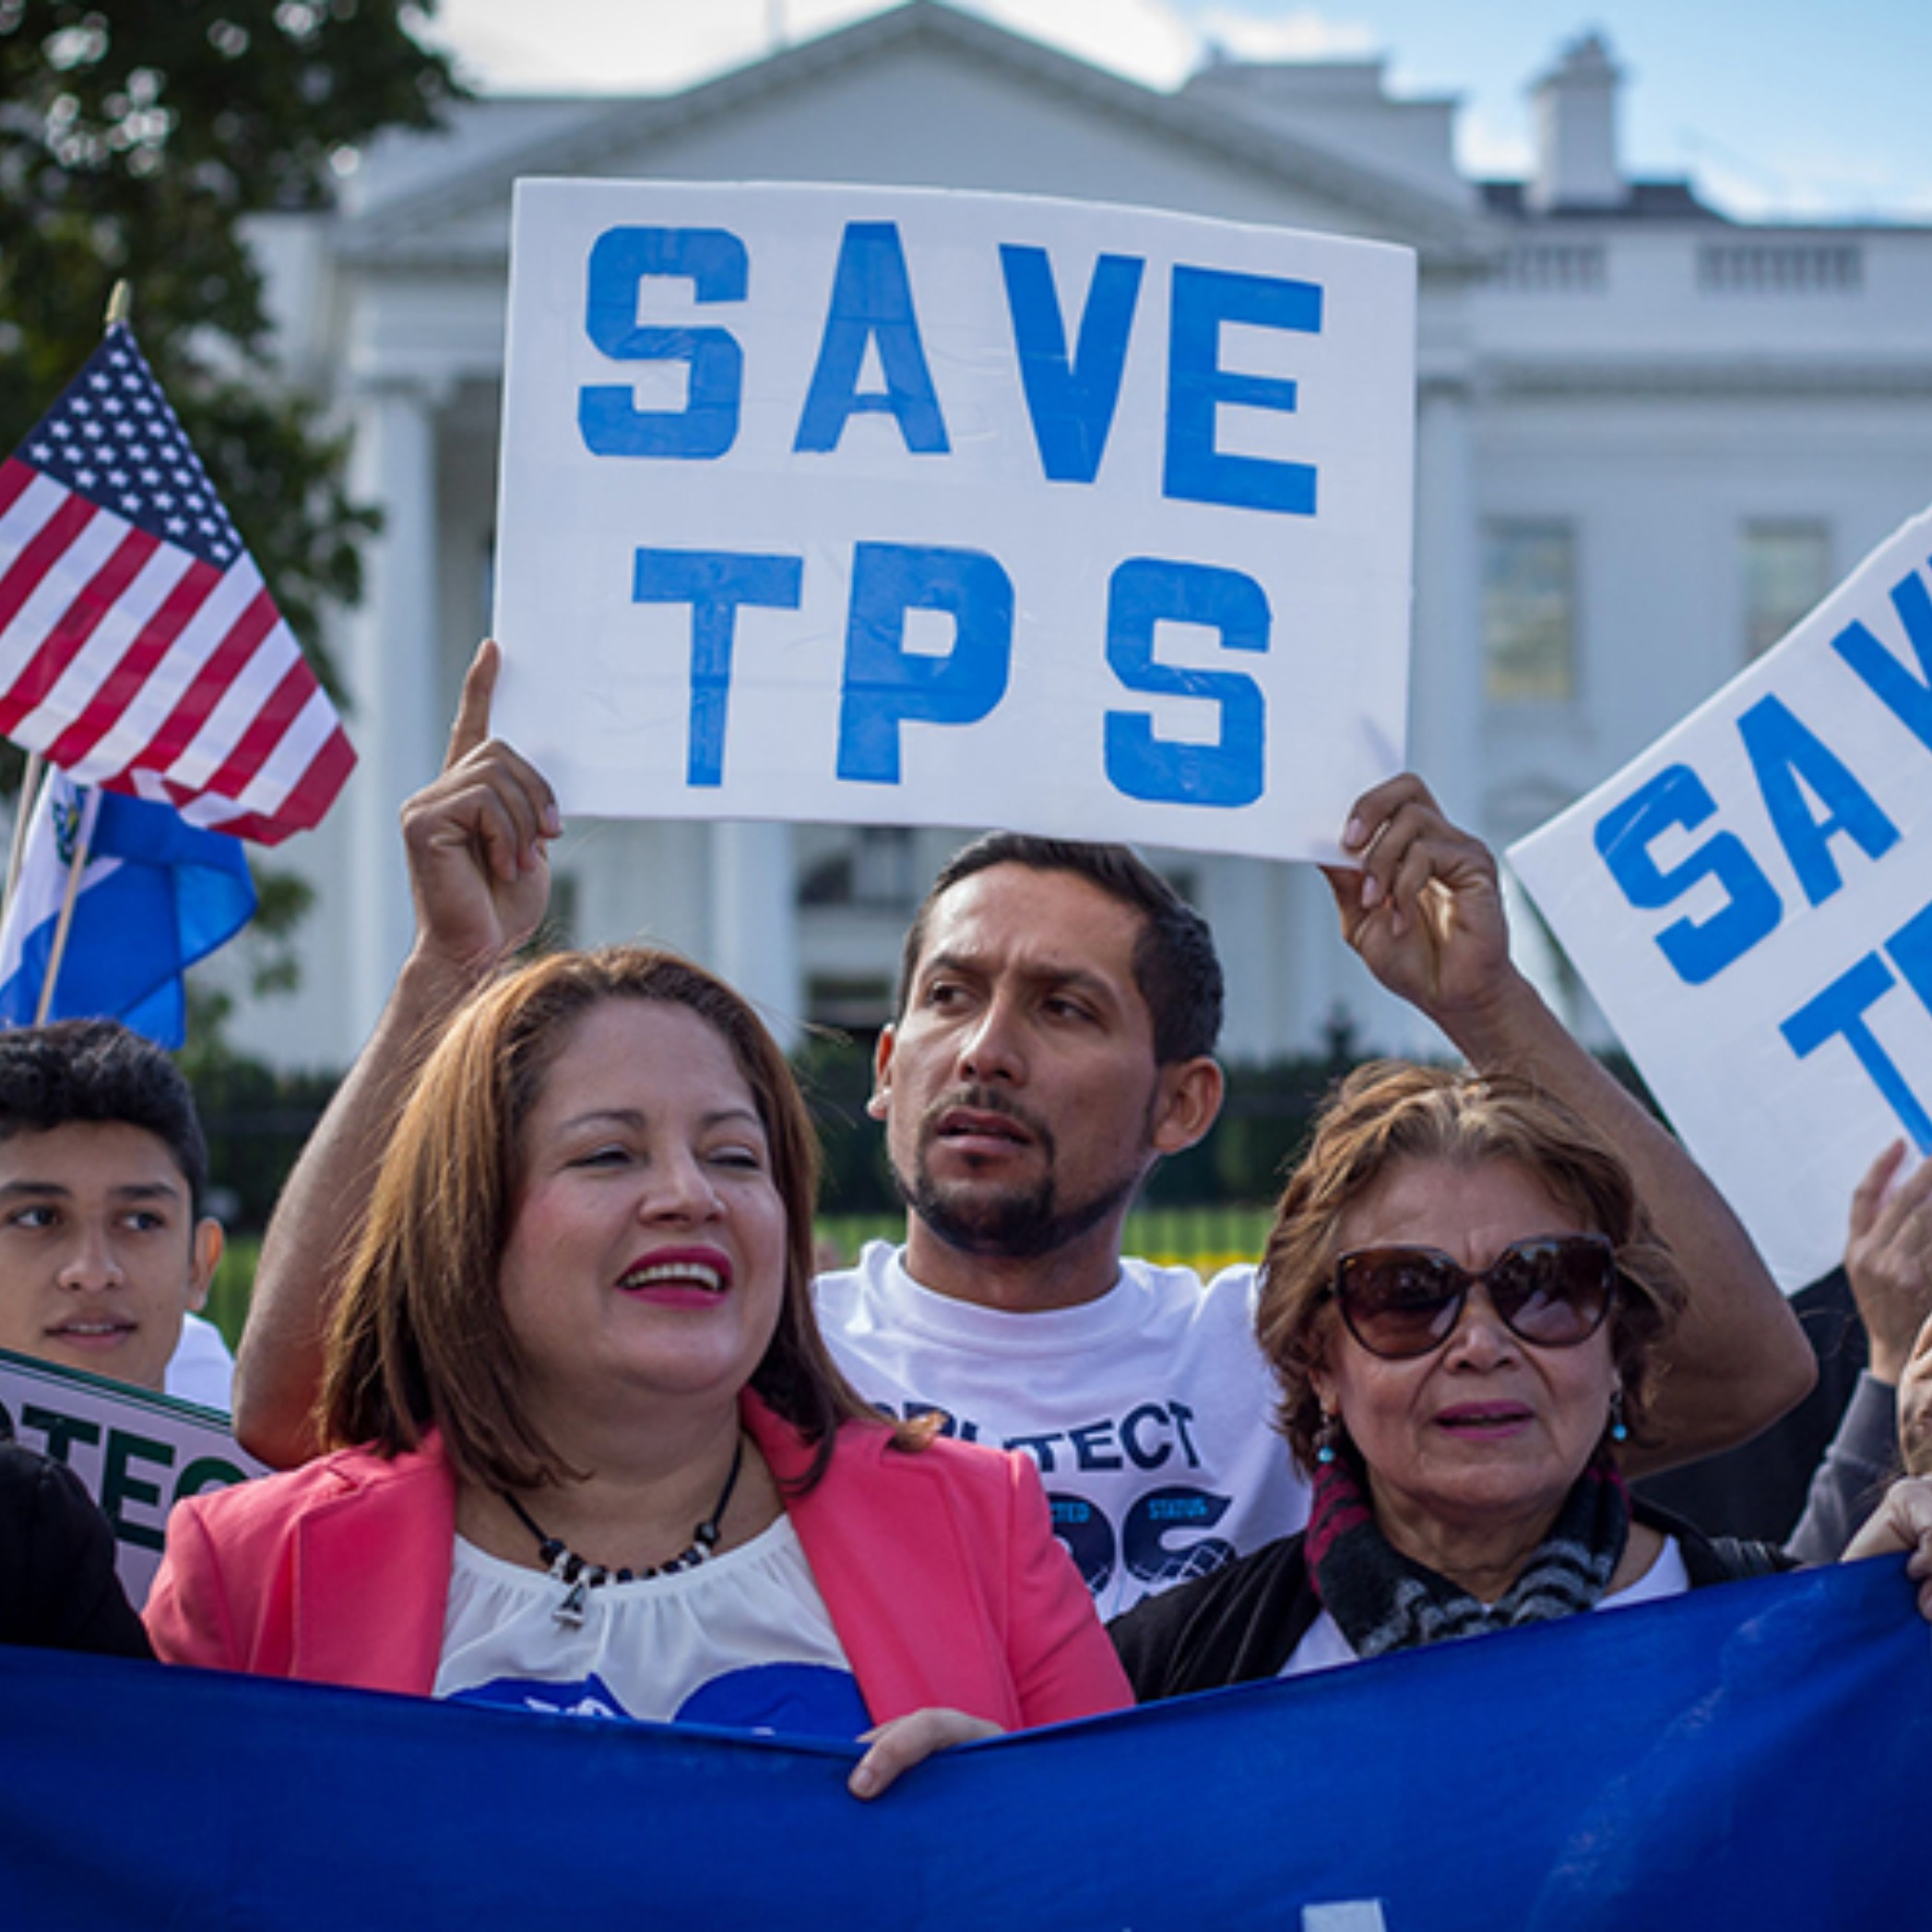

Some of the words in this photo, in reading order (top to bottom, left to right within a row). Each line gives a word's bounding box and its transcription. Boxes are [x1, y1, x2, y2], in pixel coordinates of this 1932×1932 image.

[577, 220, 1323, 516] SAVE
[631, 541, 1272, 808] TPS
[1594, 551, 1932, 987] SAV
[1779, 900, 1932, 1156] T
